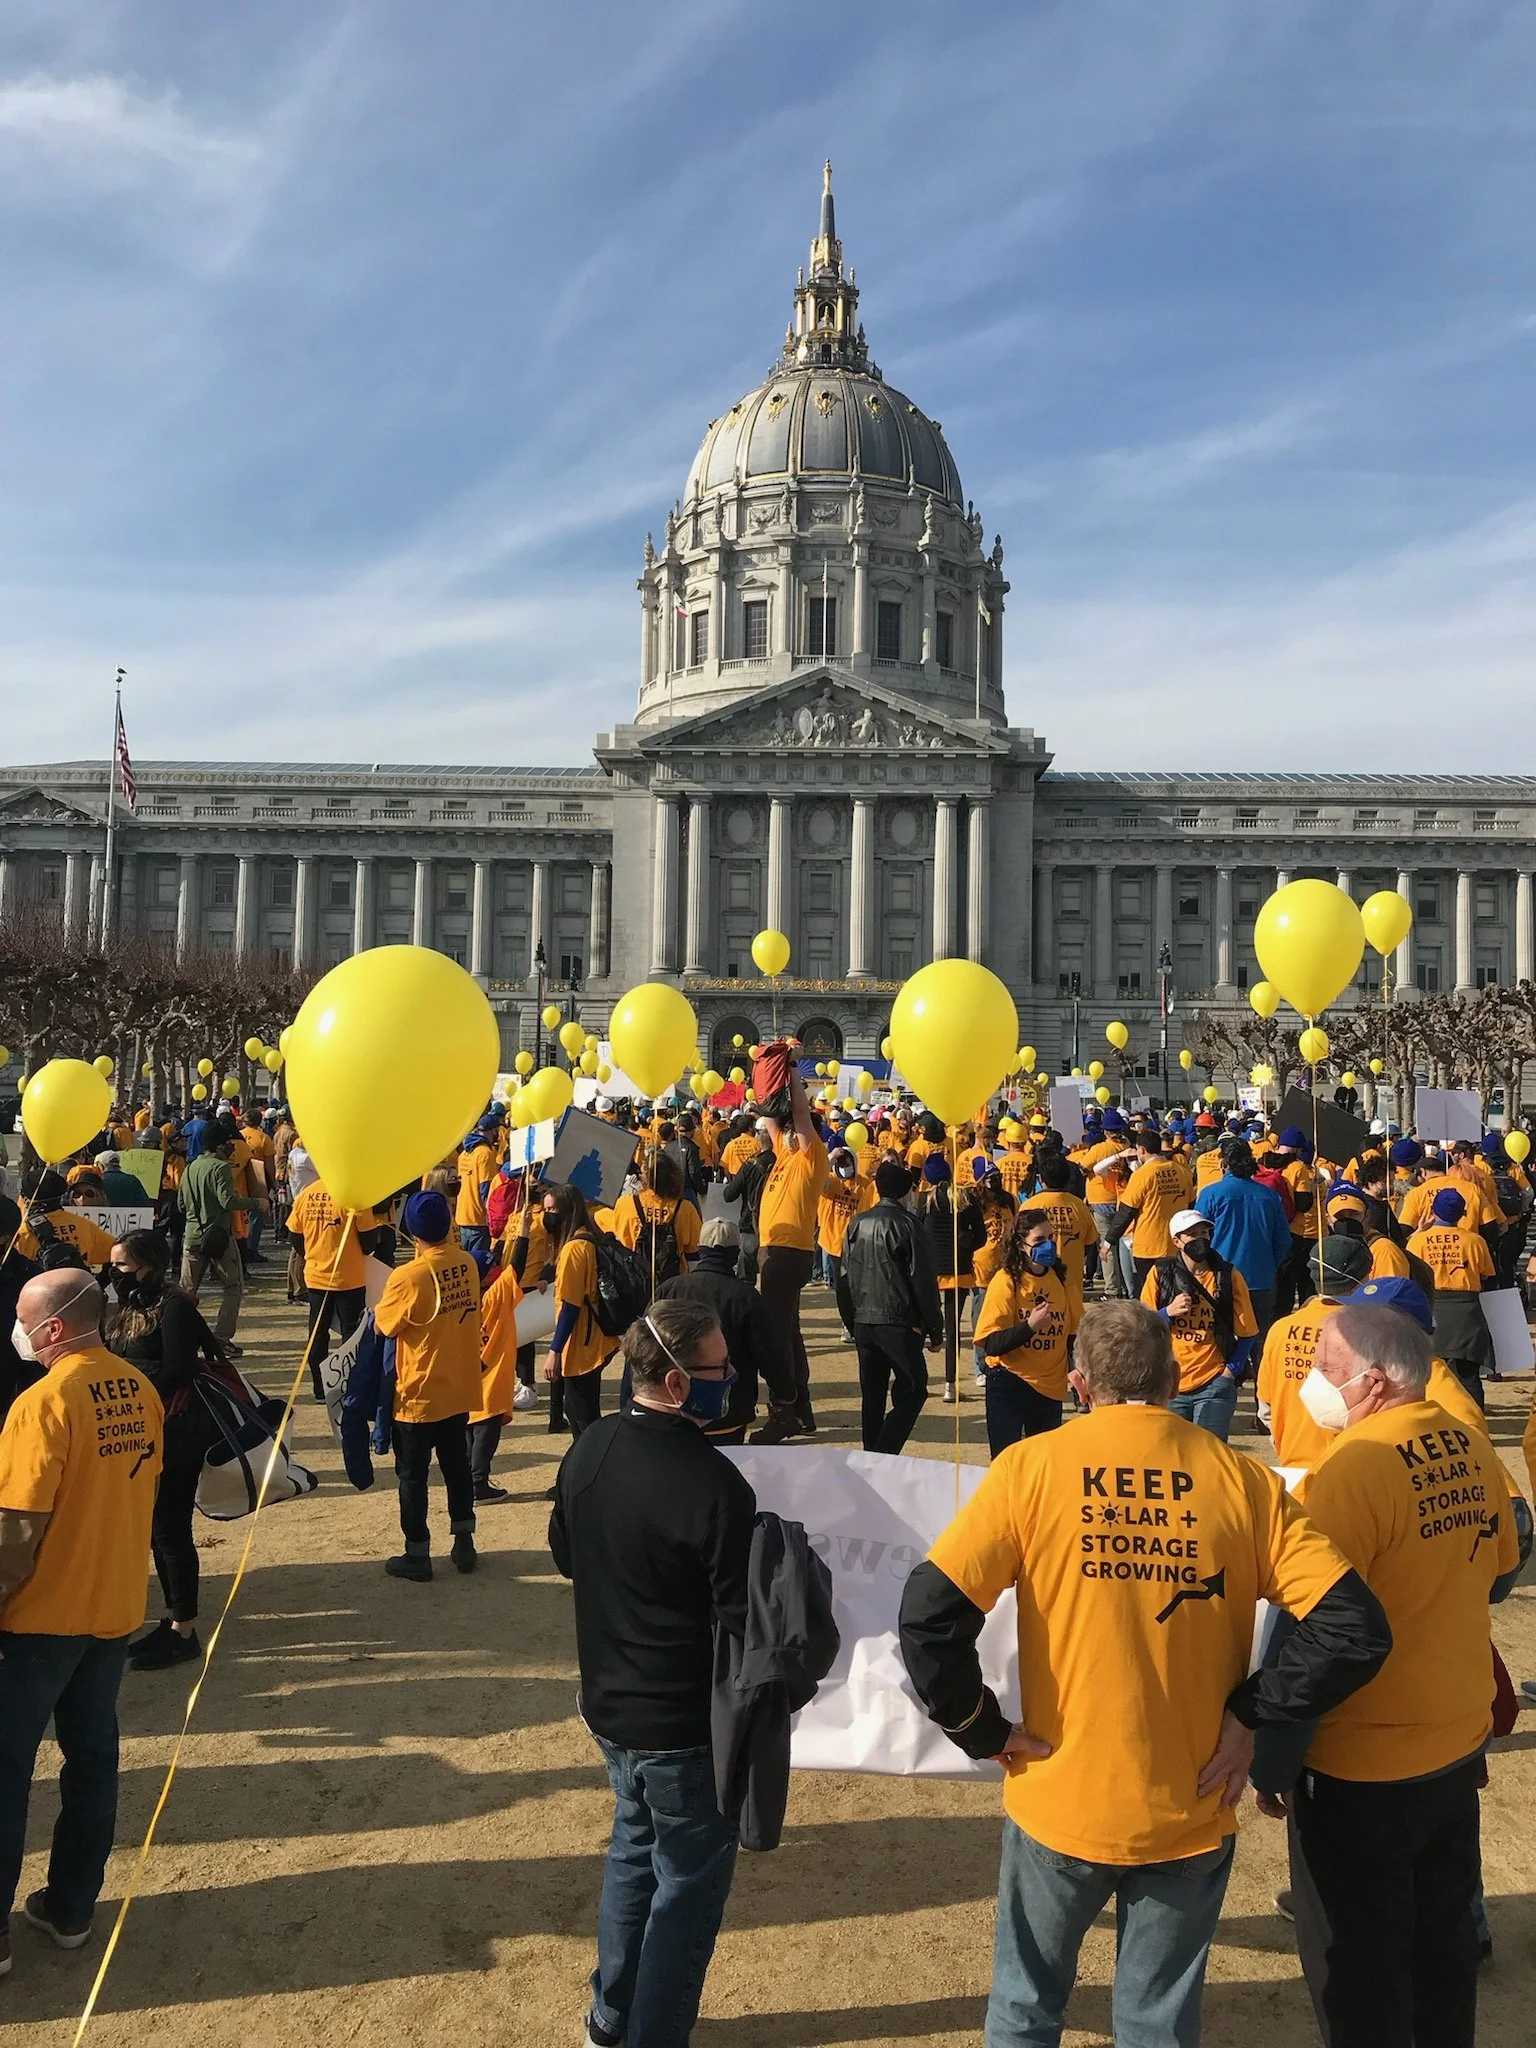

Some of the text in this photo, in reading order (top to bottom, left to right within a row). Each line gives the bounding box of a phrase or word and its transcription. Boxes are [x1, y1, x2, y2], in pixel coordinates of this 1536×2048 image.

[1155, 1170, 1178, 1178] KEEP
[646, 1207, 668, 1219] EEP
[1045, 1207, 1073, 1216] KEEP
[53, 1224, 76, 1236] EEP
[1426, 1234, 1460, 1244] KEEP
[441, 1289, 472, 1304] TORAGE
[1050, 1311, 1065, 1321] MY
[1287, 1325, 1323, 1343] KEE
[1285, 1343, 1316, 1355] SOLA
[1284, 1357, 1313, 1370] STOR
[88, 1378, 140, 1404] KEEP
[95, 1403, 133, 1421] SOLAR
[97, 1421, 146, 1441] STORAGE
[99, 1438, 146, 1458] GROWING
[1395, 1430, 1470, 1469] KEEP
[1083, 1467, 1194, 1501] KEEP
[1411, 1461, 1470, 1492] SOLAR
[1418, 1485, 1486, 1518] STORAGE
[1081, 1501, 1198, 1529] SOLAR +
[1420, 1509, 1488, 1540] GROWING
[1081, 1535, 1198, 1558] STORAGE
[1081, 1561, 1197, 1584] GROWING
